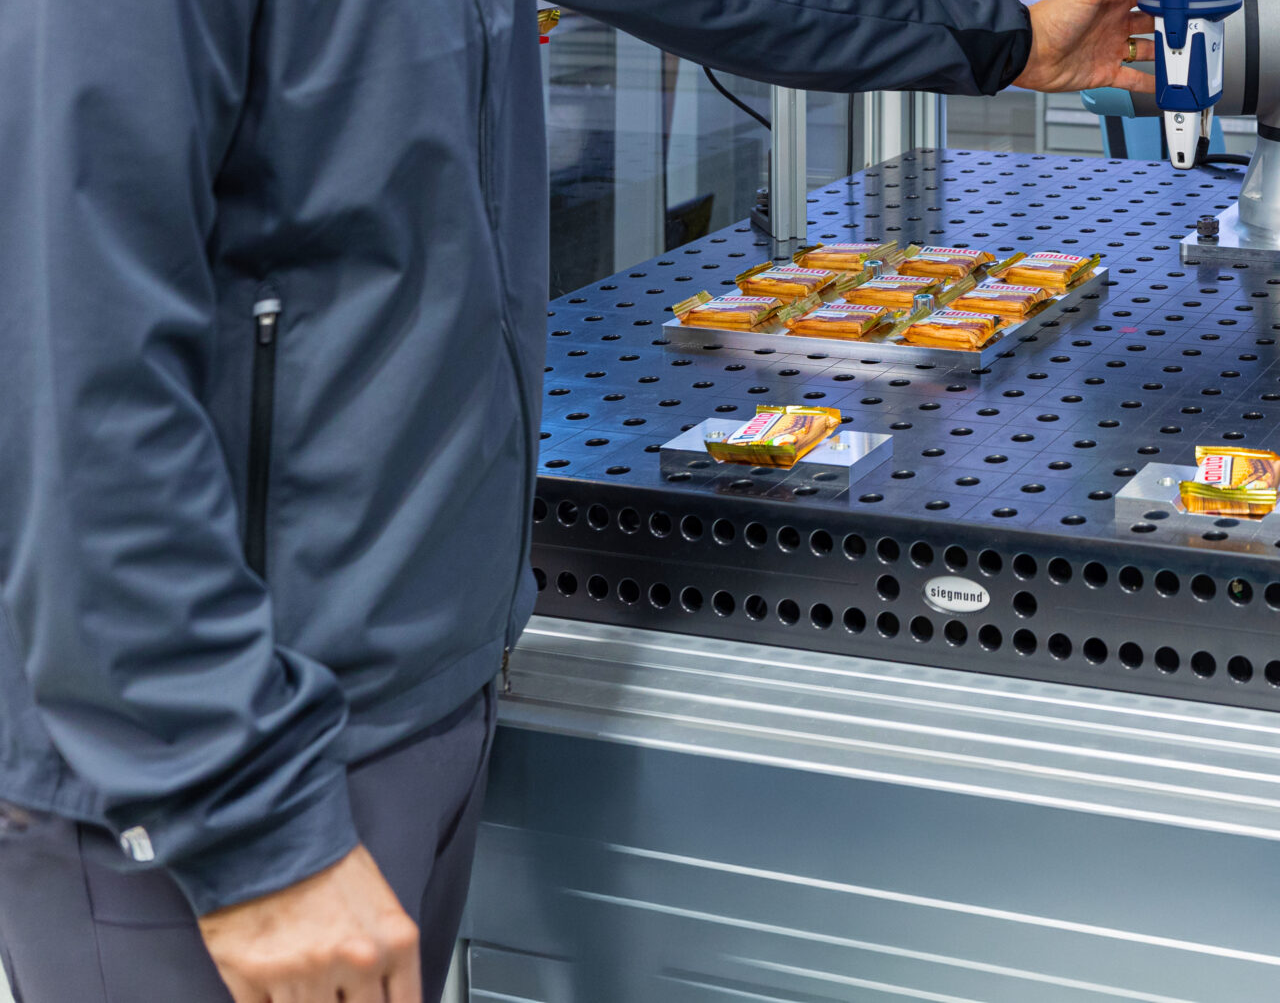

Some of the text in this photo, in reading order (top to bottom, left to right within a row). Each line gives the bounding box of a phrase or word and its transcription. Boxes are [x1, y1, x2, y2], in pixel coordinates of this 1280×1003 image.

[923, 246, 979, 255] hanuta
[770, 266, 828, 275] hanuta
[980, 283, 1039, 292] hanuta
[732, 413, 775, 440] hanuta
[931, 586, 983, 603] siegmund
